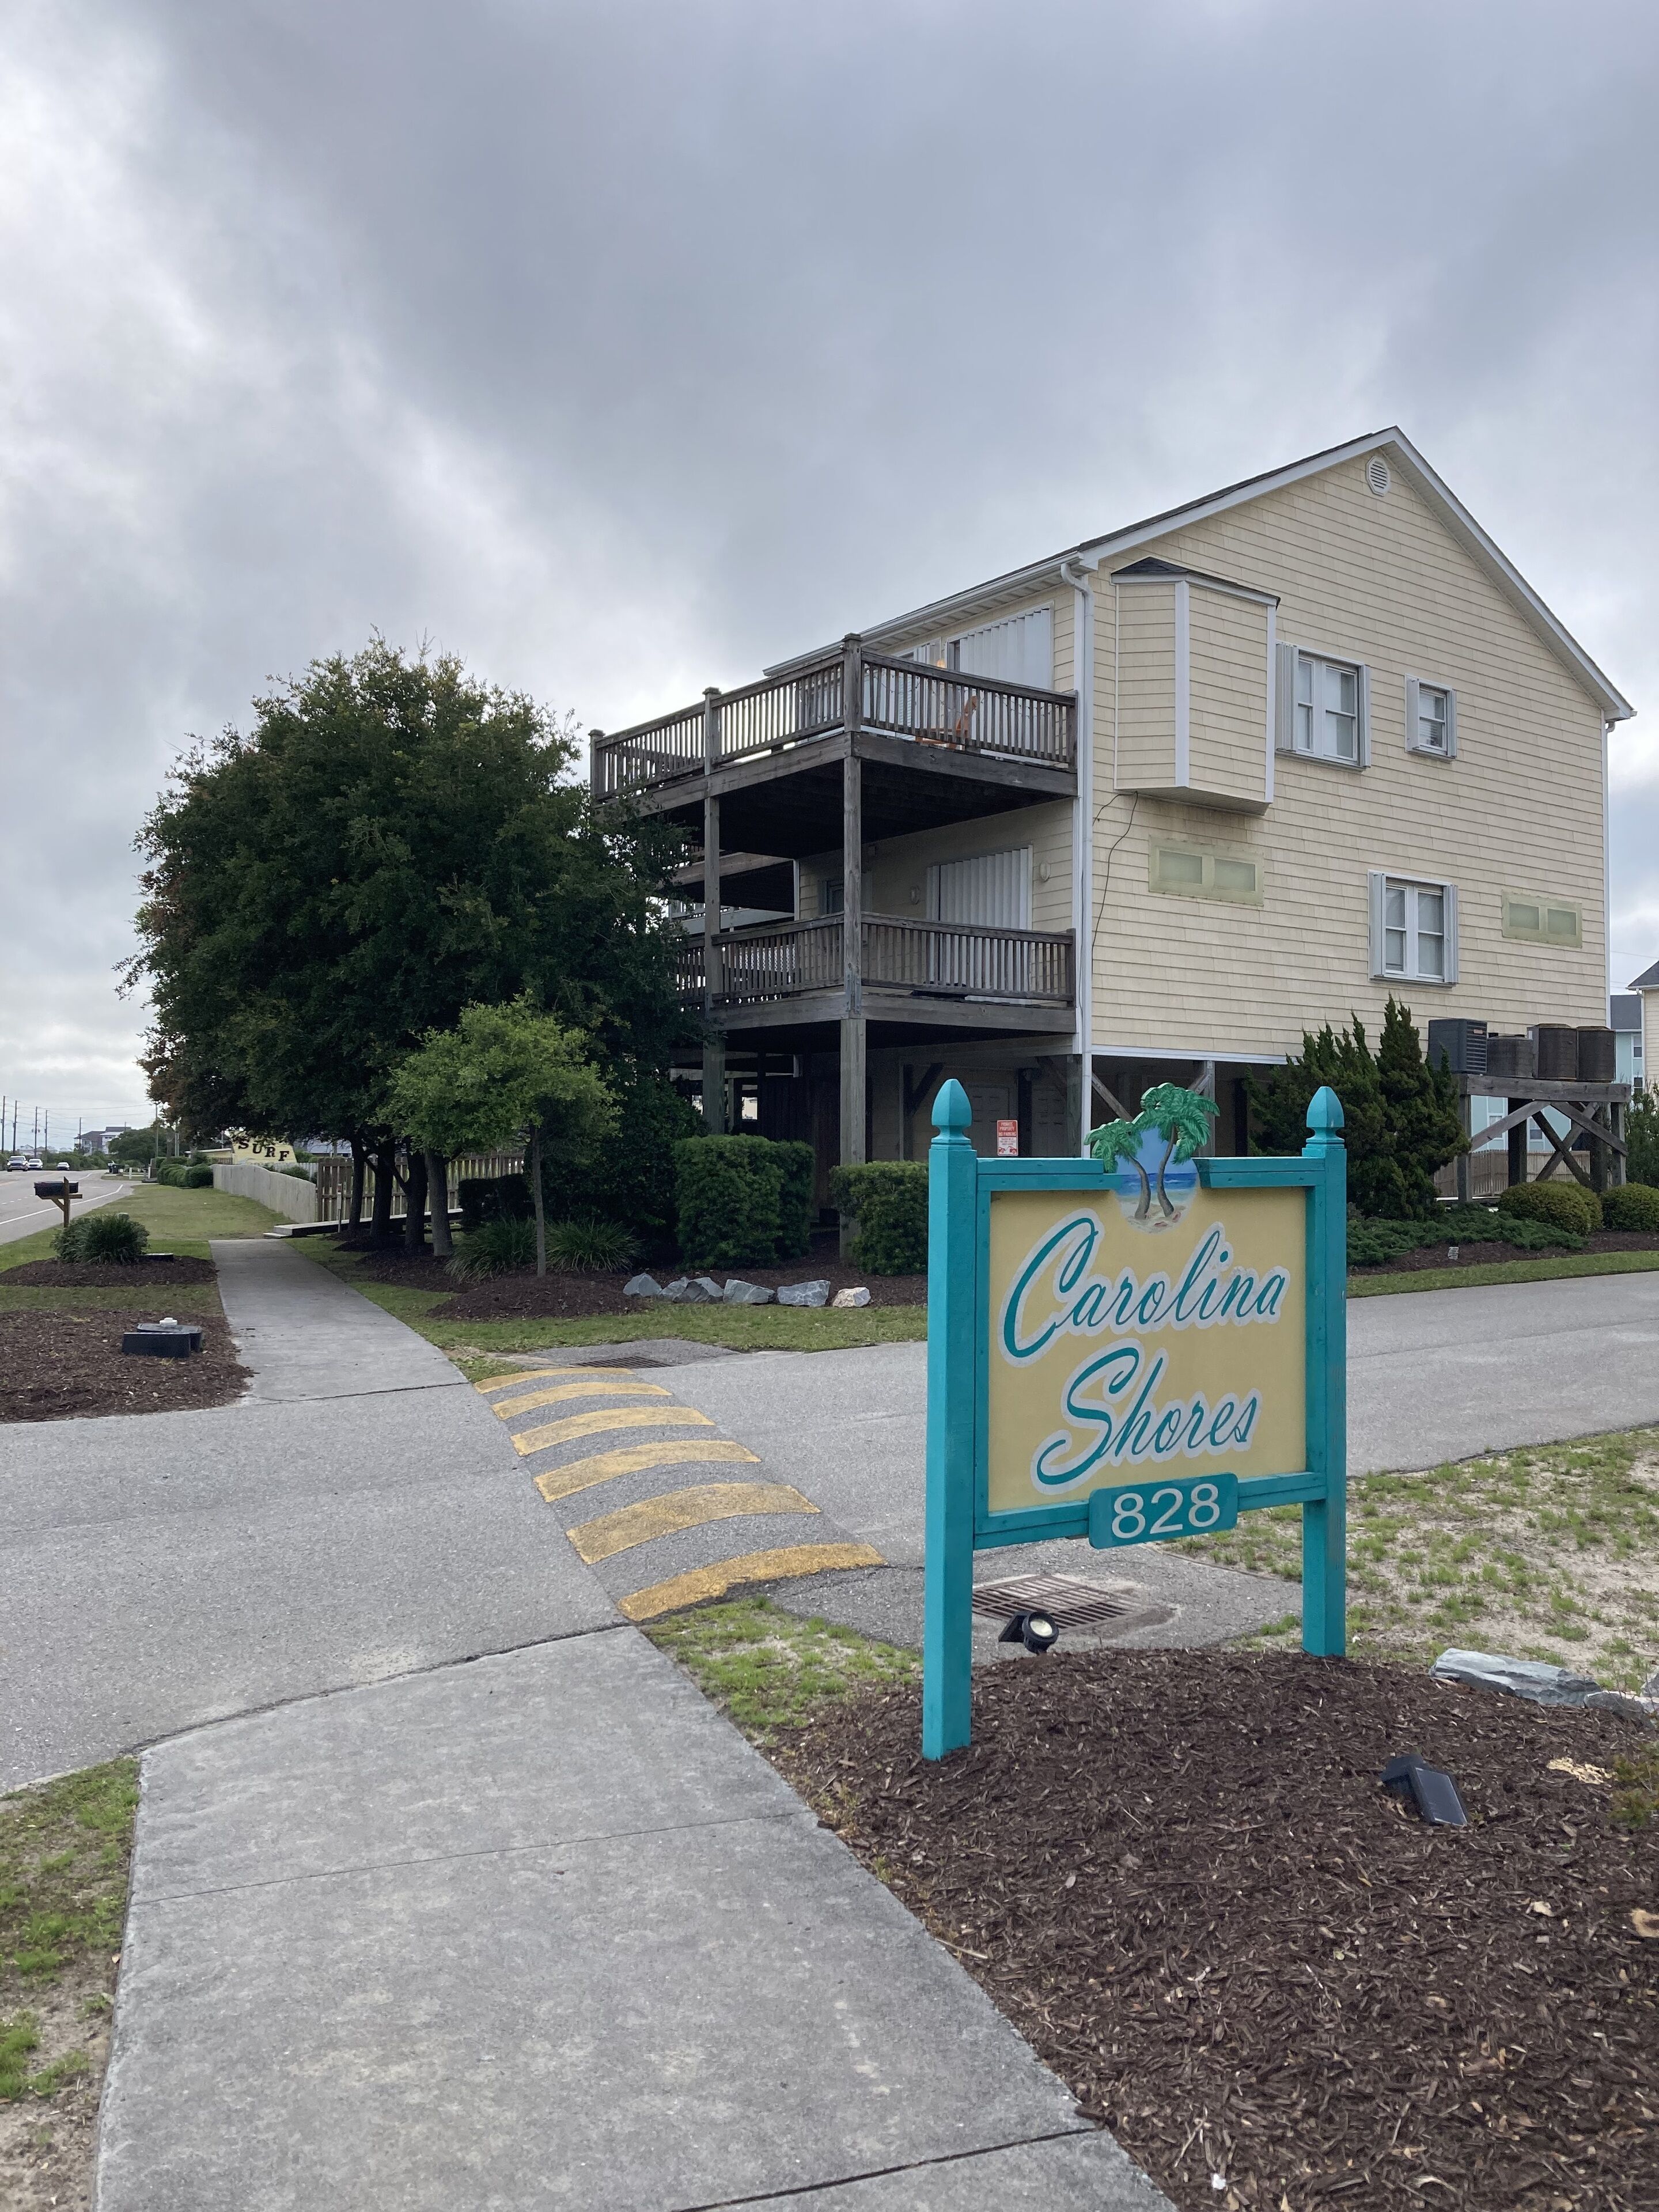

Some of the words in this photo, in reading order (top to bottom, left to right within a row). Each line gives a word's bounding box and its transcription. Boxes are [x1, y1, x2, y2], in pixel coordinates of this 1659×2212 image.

[238, 1138, 290, 1161] SURF
[1003, 1217, 1286, 1358] Carolina
[1037, 1347, 1257, 1485] Shores
[1112, 1483, 1221, 1540] 828
